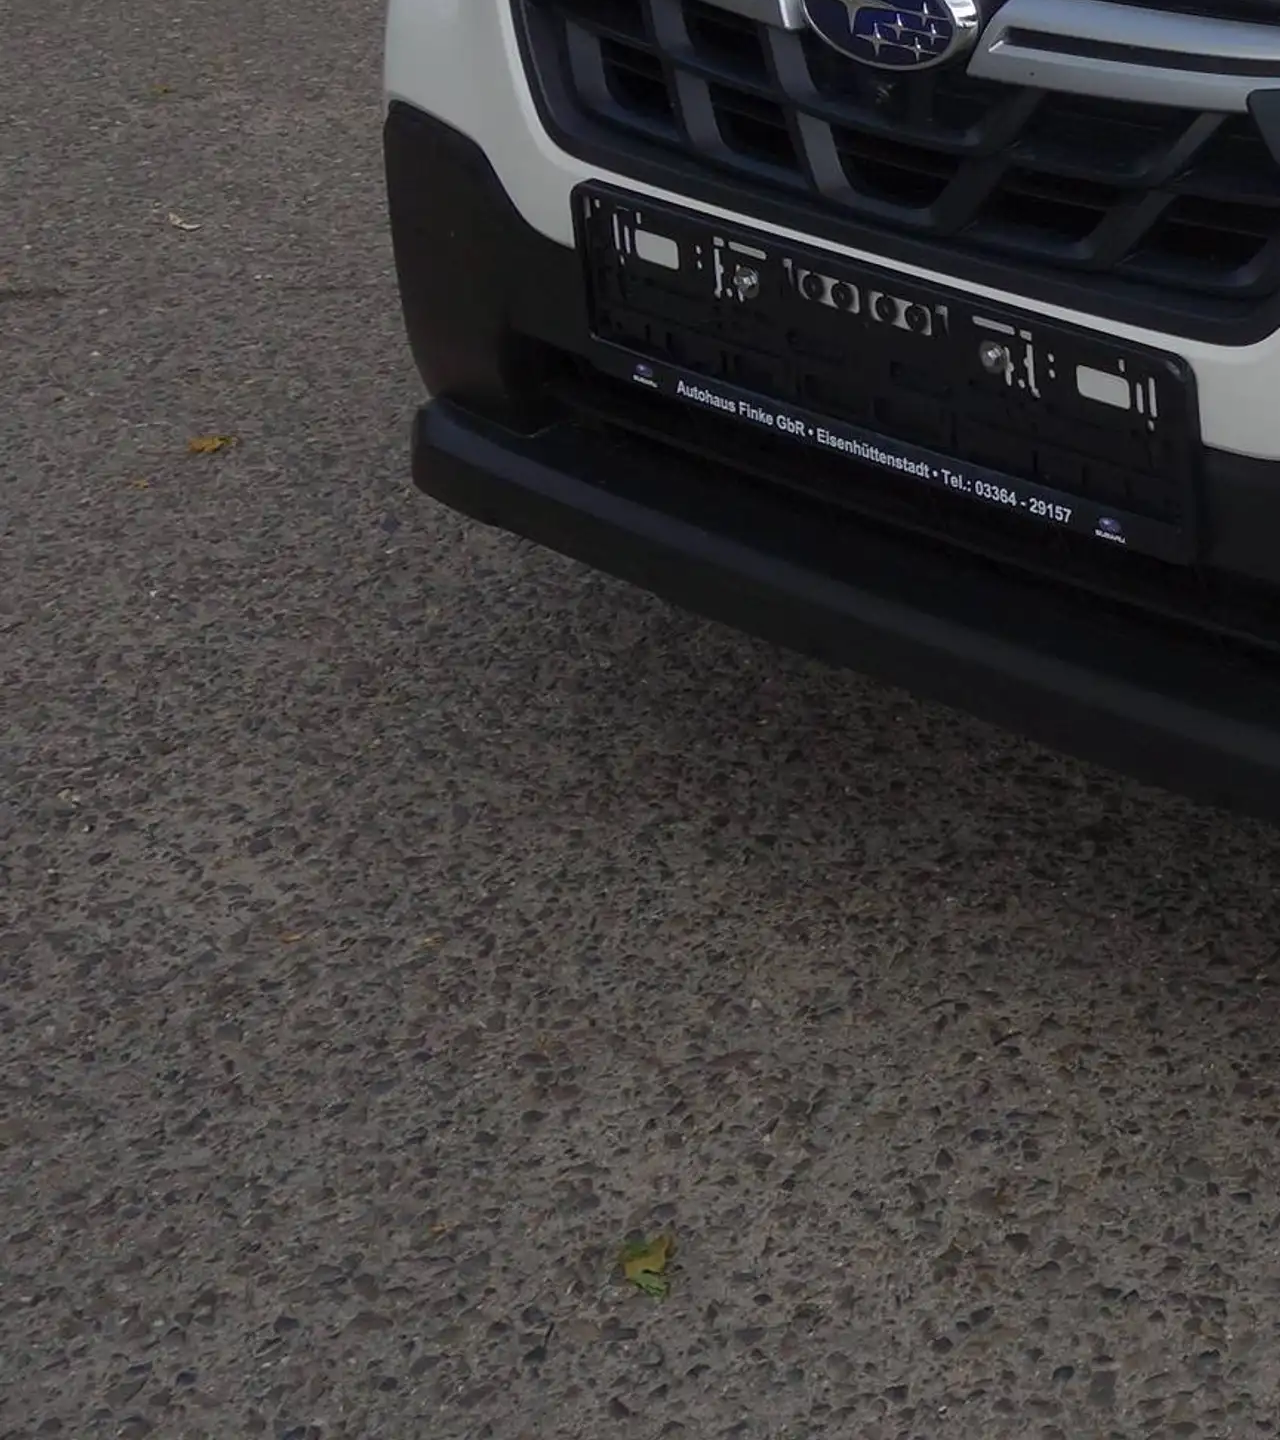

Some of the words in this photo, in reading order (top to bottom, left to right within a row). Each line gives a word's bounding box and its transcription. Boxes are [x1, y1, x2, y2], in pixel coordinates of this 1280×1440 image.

[676, 380, 736, 413] Autohaus
[738, 401, 773, 427] Finke
[776, 415, 806, 437] GbR
[816, 428, 930, 480] Eisenhüttenstadt
[941, 468, 972, 493] Tel.:
[974, 480, 1017, 507] 03364
[1029, 497, 1073, 524] 29157
